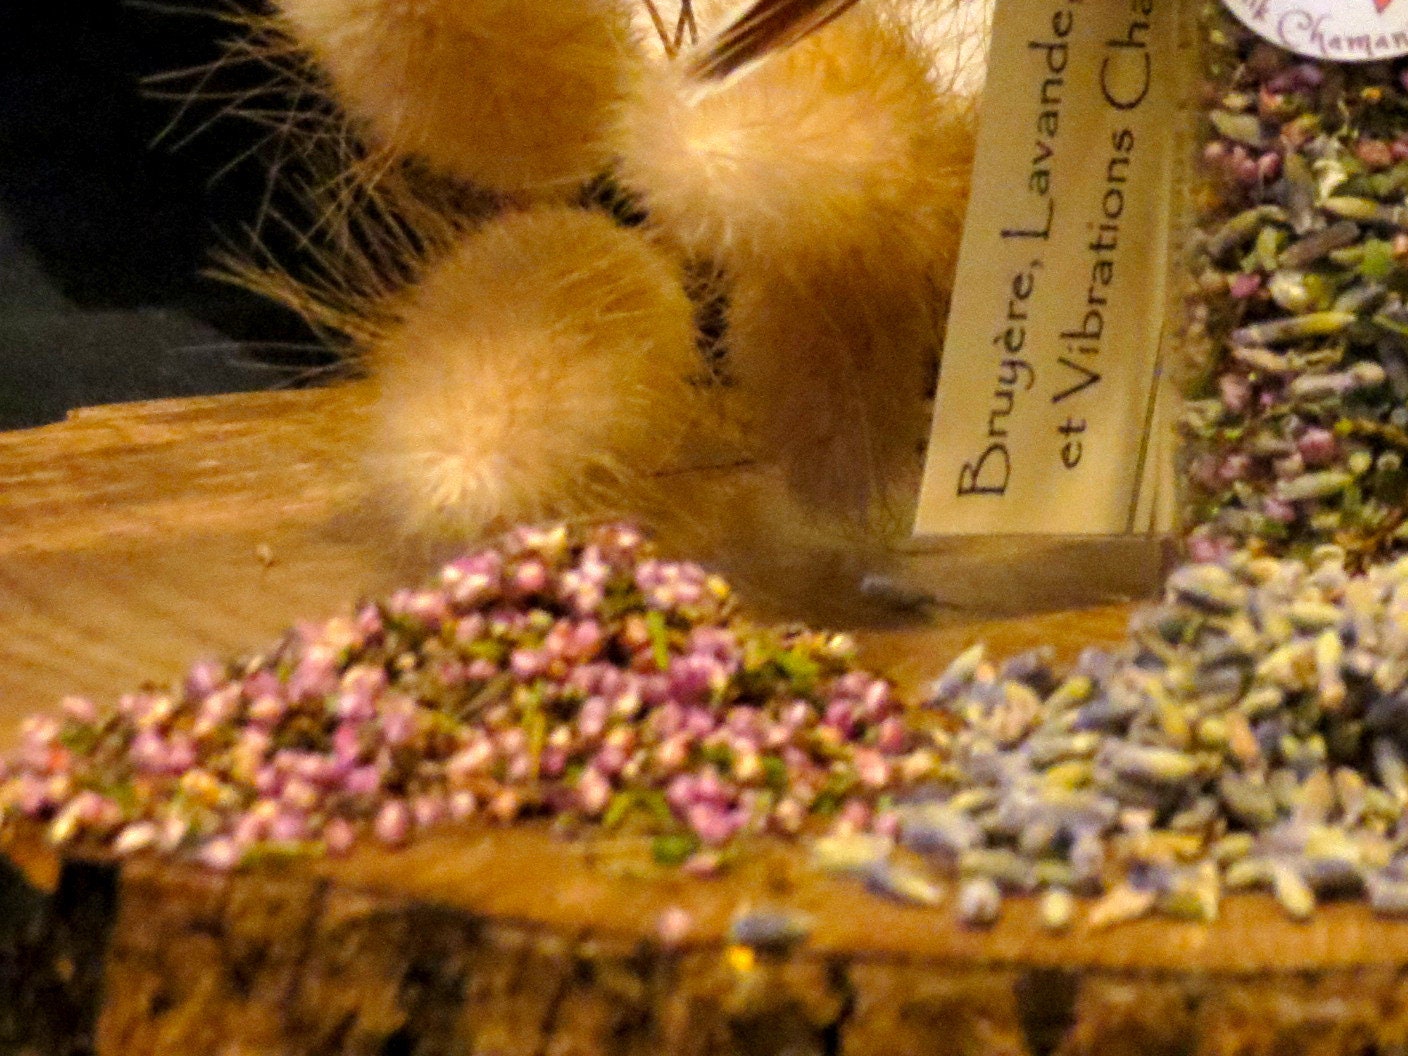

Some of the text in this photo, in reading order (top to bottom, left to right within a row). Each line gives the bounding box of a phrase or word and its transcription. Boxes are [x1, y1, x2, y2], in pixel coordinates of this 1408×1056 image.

[956, 259, 1046, 498] Bruyère,
[1052, 127, 1135, 405] Vibrations
[1058, 415, 1087, 470] et
